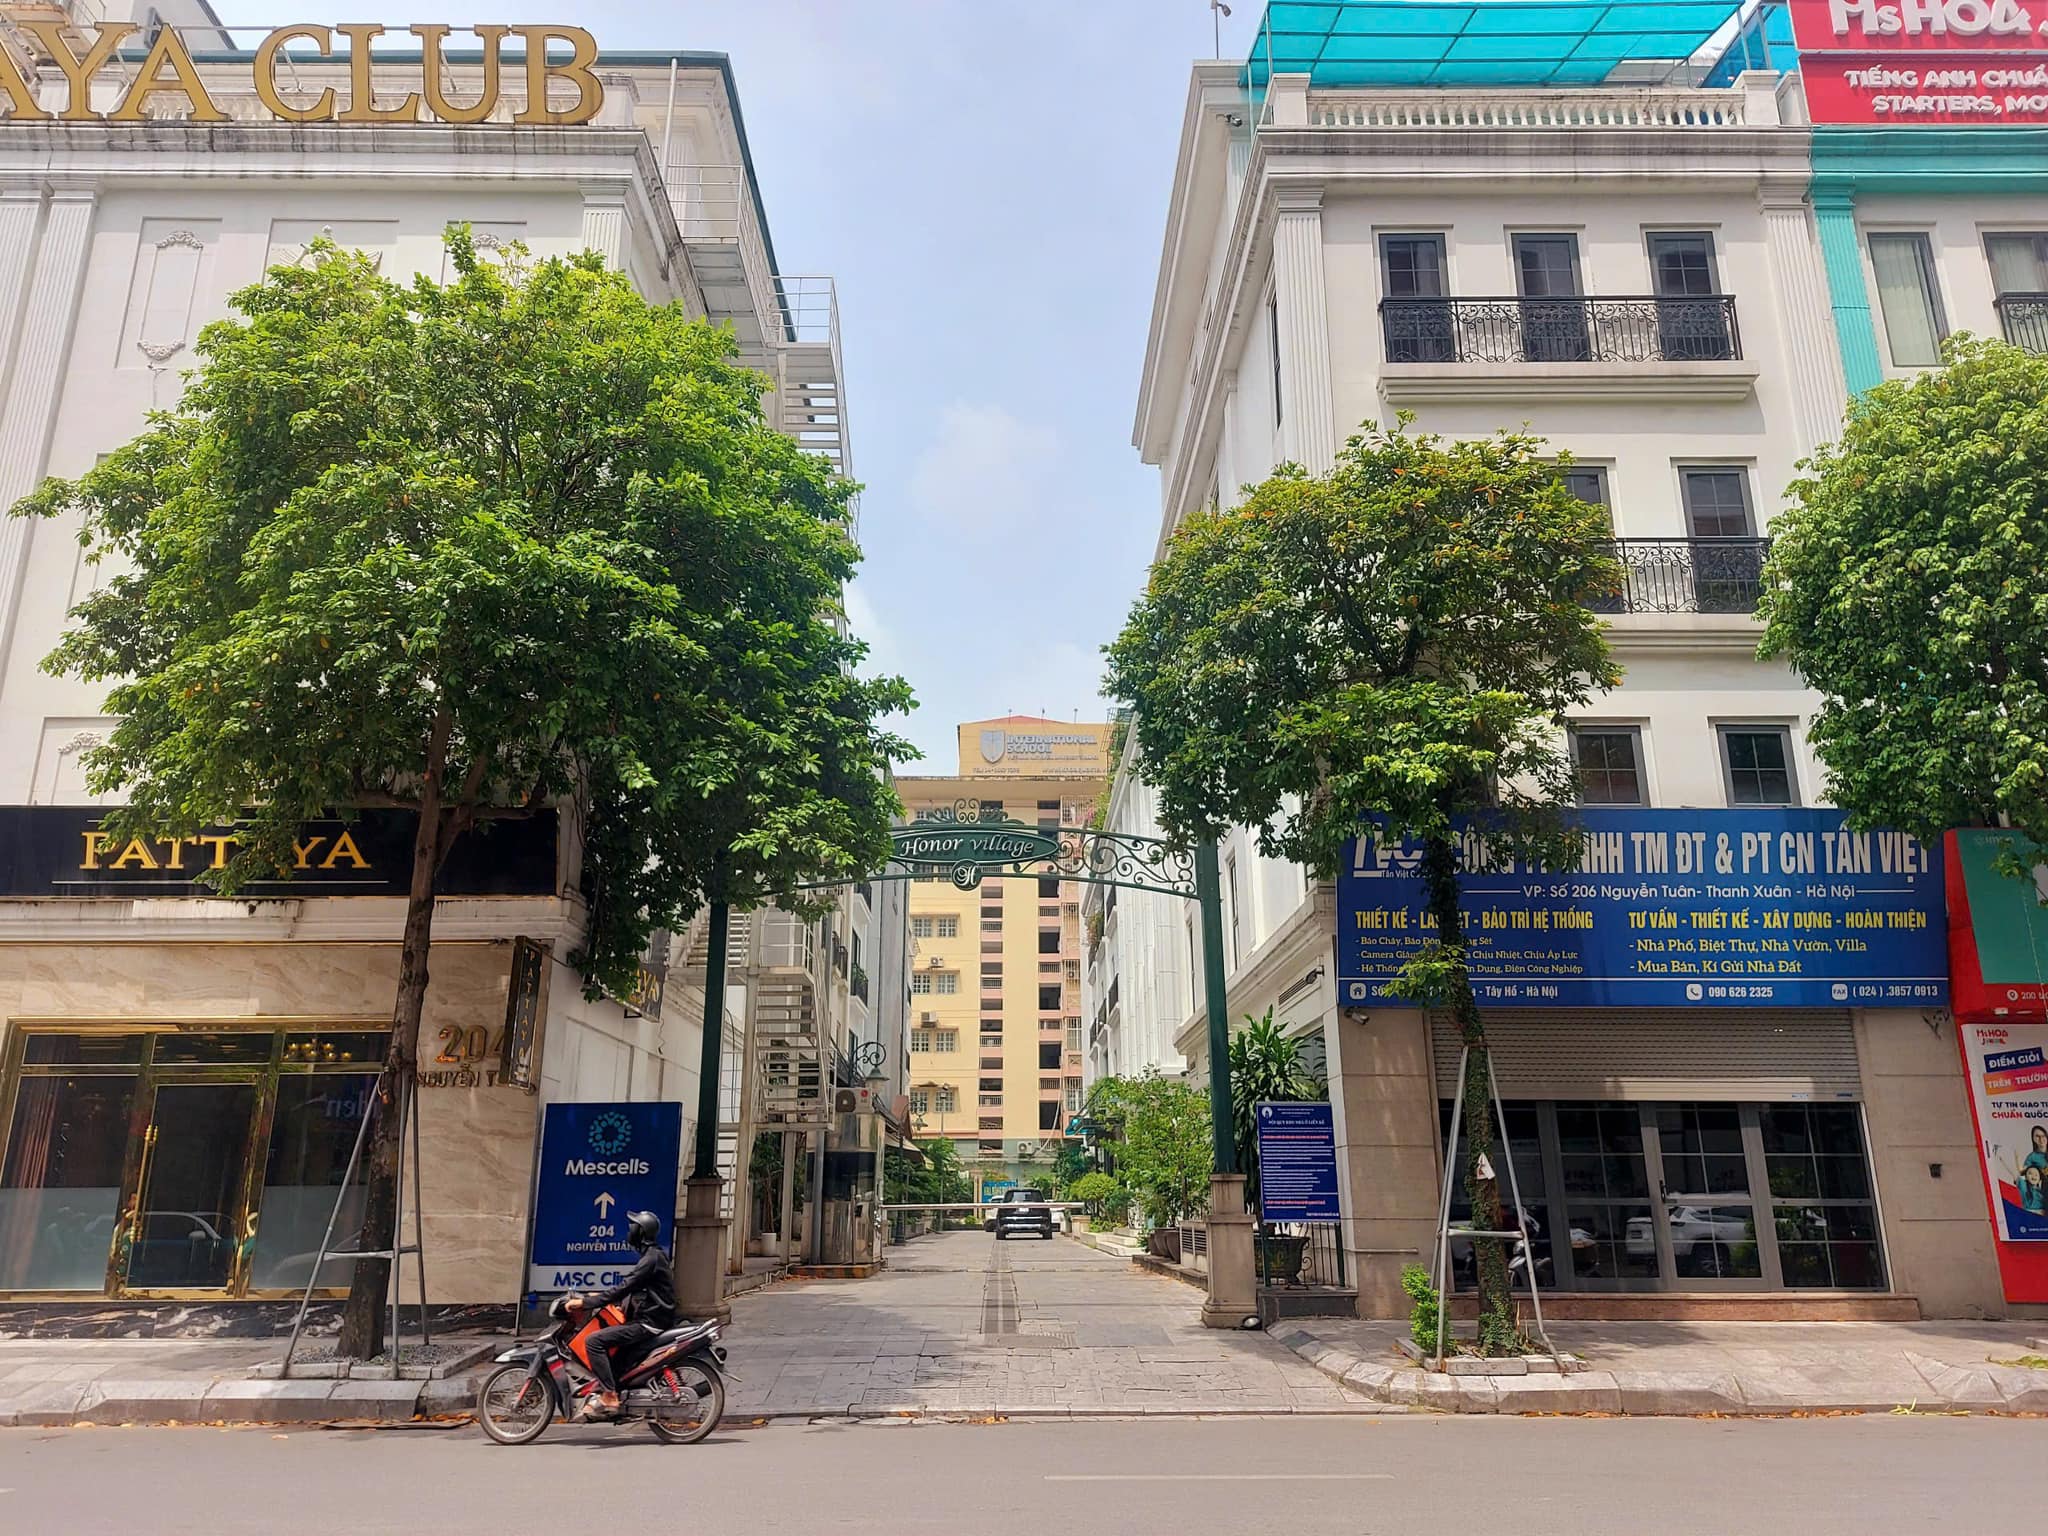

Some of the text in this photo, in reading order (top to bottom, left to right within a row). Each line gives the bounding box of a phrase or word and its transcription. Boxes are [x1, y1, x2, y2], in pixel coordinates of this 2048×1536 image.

[252, 23, 606, 126] CLUB
[1844, 64, 1919, 88] TIẾNG
[1923, 70, 1977, 88] ANH
[1872, 95, 2002, 115] STARTERS,
[1007, 735, 1098, 745] INTERNATIONAL
[1007, 743, 1053, 754] SCHOOL
[79, 831, 372, 870] PATTYA
[901, 834, 1034, 858] Honor village
[1557, 832, 1624, 874] NHH
[1631, 832, 1668, 873] TM
[1675, 832, 1706, 873] ĐT
[1715, 832, 1733, 873] &
[1742, 832, 1772, 873] PT
[1780, 832, 1815, 873] CN
[1821, 820, 1871, 873] TÂN
[1523, 885, 1546, 898] VP:
[1550, 882, 1568, 898] Số
[1572, 886, 1597, 898] 206
[1601, 883, 1658, 900] Nguyễn
[1706, 885, 1750, 897] Thanh
[1753, 885, 1791, 897] Xuân
[1806, 885, 1827, 897] Hà
[1831, 885, 1855, 899] Nội
[1355, 906, 1389, 928] THIẾT
[1392, 906, 1408, 928] KẾ
[1482, 905, 1507, 928] BẢO
[1510, 907, 1530, 928] TRÌ
[1533, 907, 1549, 932] HỆ
[1552, 905, 1593, 928] THỐNG
[1629, 911, 1648, 928] TƯ
[1649, 906, 1677, 928] VẤN
[1690, 907, 1728, 928] THIẾT
[1731, 907, 1750, 928] KẾ
[1763, 909, 1789, 928] XÂY
[1793, 911, 1832, 932] DỰNG
[1845, 908, 1884, 928] HOÀN
[1886, 908, 1927, 931] THIỆN
[1360, 936, 1377, 945] Báo
[1404, 936, 1421, 945] Báo
[1479, 937, 1494, 945] Sét
[1636, 939, 1665, 951] Nhà
[1668, 938, 1697, 953] Phố,
[1699, 939, 1726, 954] Biệt
[1728, 939, 1759, 954] Thự,
[1761, 939, 1789, 951] Nhà
[1792, 939, 1832, 953] Vườn,
[1835, 939, 1868, 951] Villa
[1360, 950, 1394, 959] Camera
[1472, 950, 1494, 960] Chịu
[1524, 950, 1545, 960] Chịu
[1547, 949, 1560, 961] Áp
[1562, 950, 1578, 960] Lực
[1361, 964, 1374, 973] Hệ
[1376, 964, 1400, 973] Thốn
[1504, 965, 1526, 973] Điện
[1527, 965, 1550, 974] Công
[1551, 965, 1583, 974] Nghiệp
[1637, 960, 1668, 973] Mua
[1670, 960, 1700, 974] Bán,
[1702, 960, 1719, 973] Kí
[1720, 959, 1744, 973] Gửi
[1747, 960, 1775, 973] Nhà
[1778, 959, 1802, 973] Đất
[1485, 985, 1502, 998] Tây
[1504, 985, 1517, 997] Hồ
[1526, 986, 1539, 997] Hà
[1541, 986, 1558, 999] Nội
[1708, 986, 1773, 997] 090 626 2325
[1859, 986, 1877, 997] 024
[1914, 985, 1938, 996] 0913
[1986, 1072, 2048, 1089] TRÊN TRƯỜN
[1991, 1101, 2004, 1109] TỰ
[1991, 1108, 2023, 1119] CHUẨN
[564, 1158, 650, 1176] Mescells
[589, 1225, 615, 1237] 204
[566, 1240, 607, 1252] NGUYỄN
[553, 1271, 595, 1287] MSC
